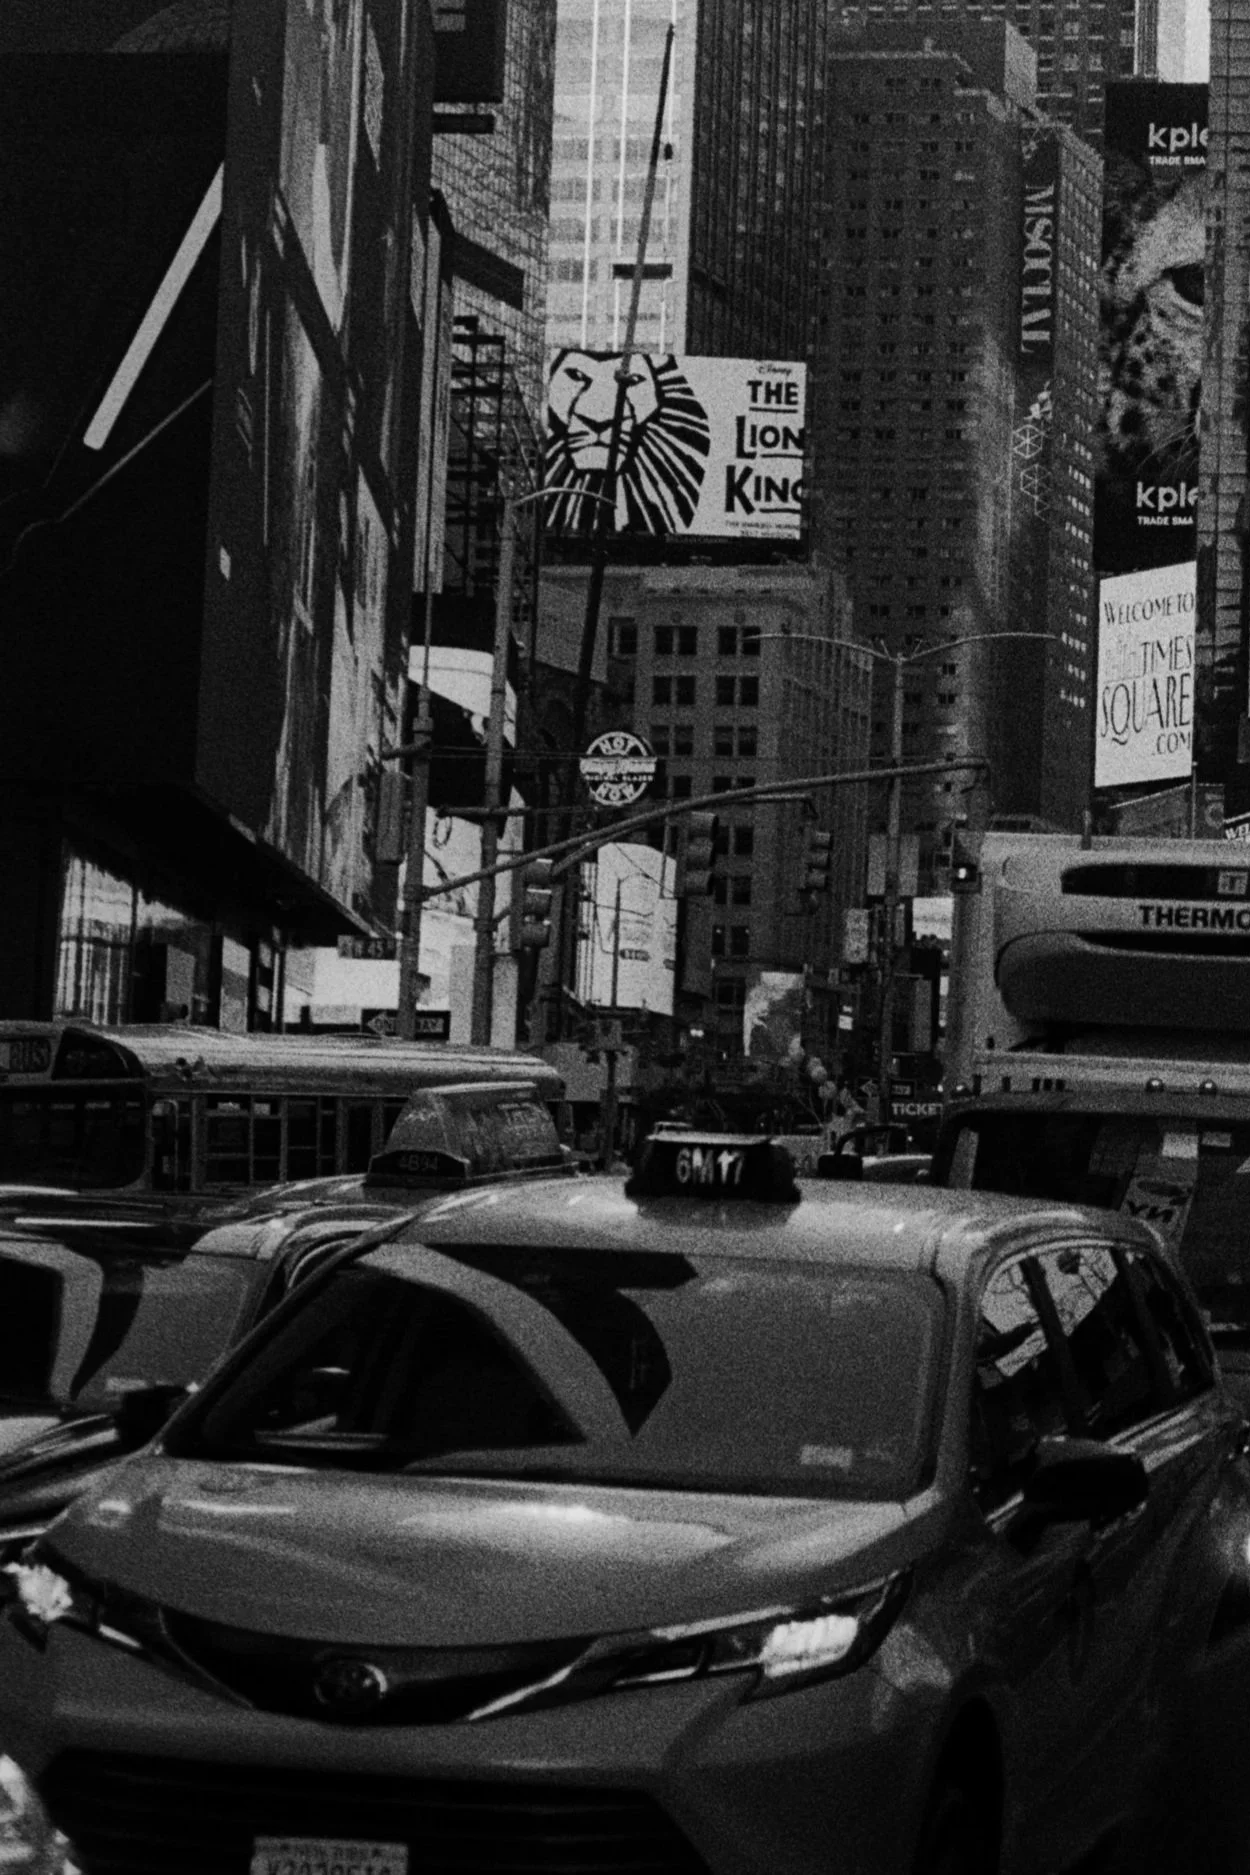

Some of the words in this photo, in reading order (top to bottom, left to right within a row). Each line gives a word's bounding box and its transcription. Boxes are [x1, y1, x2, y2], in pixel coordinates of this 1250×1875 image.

[747, 380, 799, 405] THE
[1104, 596, 1173, 625] WELCOME
[1177, 591, 1194, 614] TO
[1141, 634, 1193, 676] TIMES
[1100, 672, 1191, 746] SQUARE
